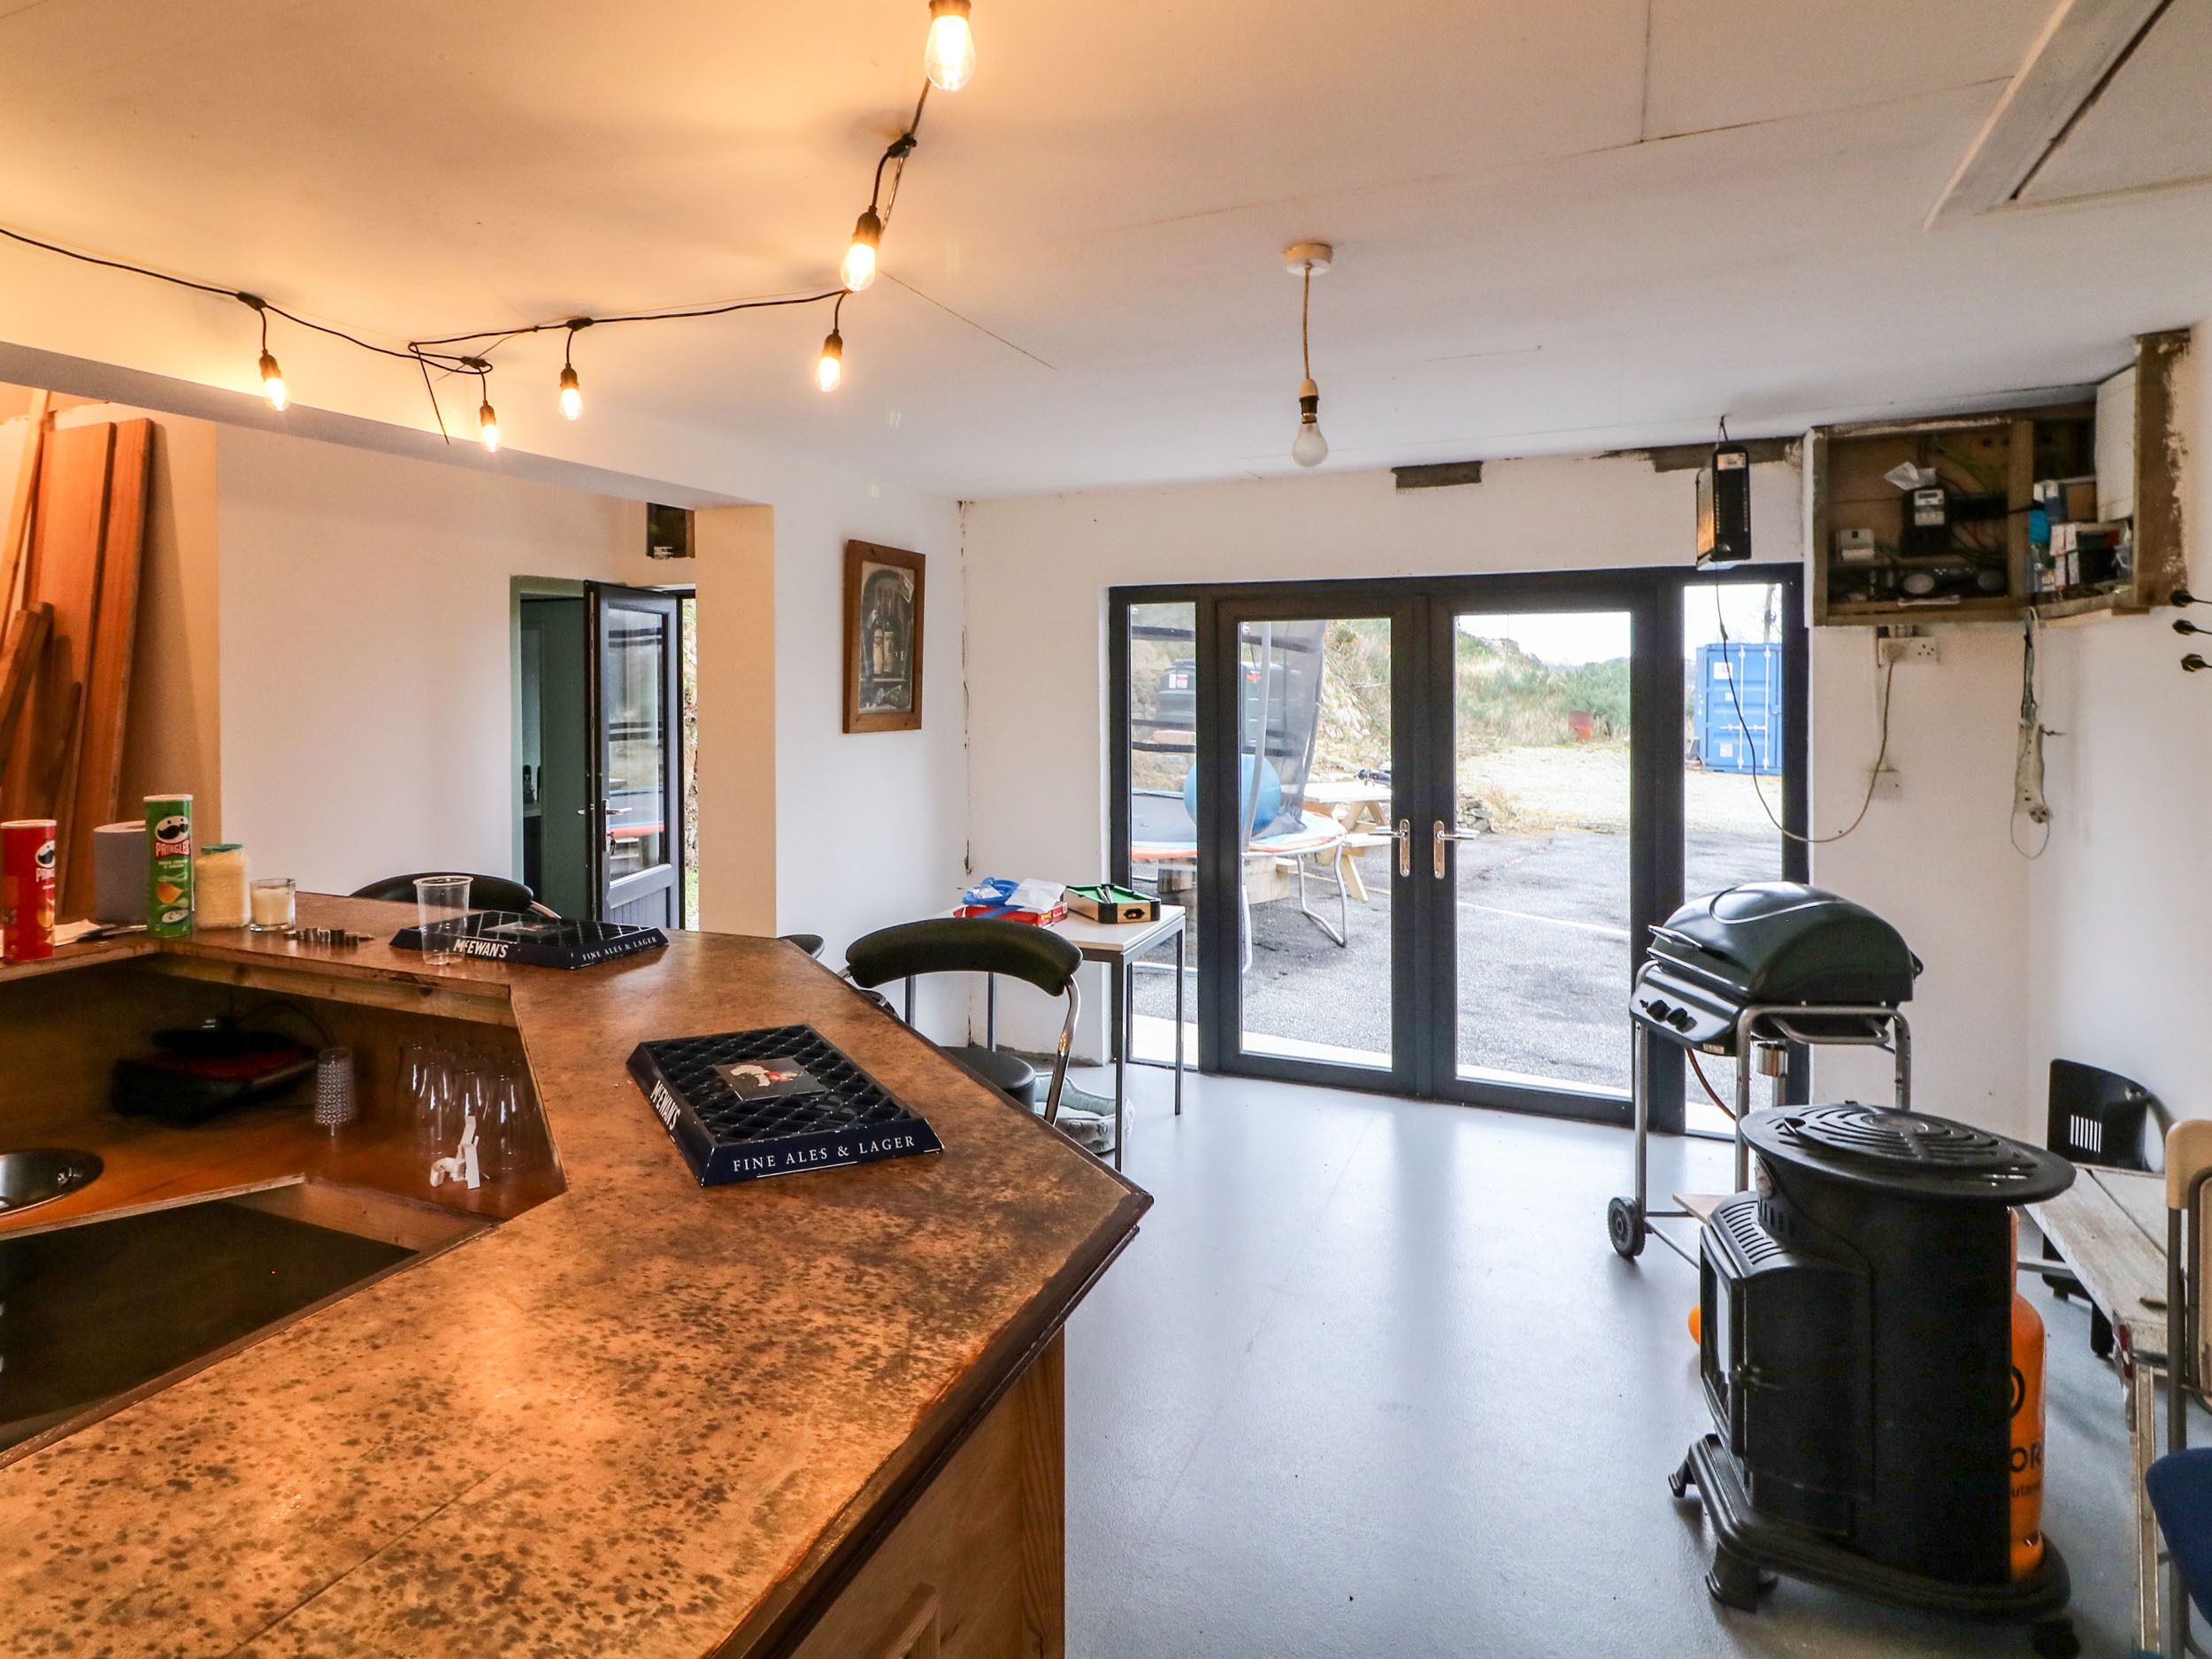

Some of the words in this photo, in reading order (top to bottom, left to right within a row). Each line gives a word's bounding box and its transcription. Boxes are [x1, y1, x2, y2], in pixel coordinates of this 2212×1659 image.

[582, 950, 602, 961] FINE
[604, 944, 622, 956] ALES
[633, 936, 657, 949] LAGER
[733, 1155, 776, 1172] FINE
[785, 1148, 827, 1164] ALES
[837, 1145, 849, 1157] &
[859, 1135, 915, 1154] LAGER
